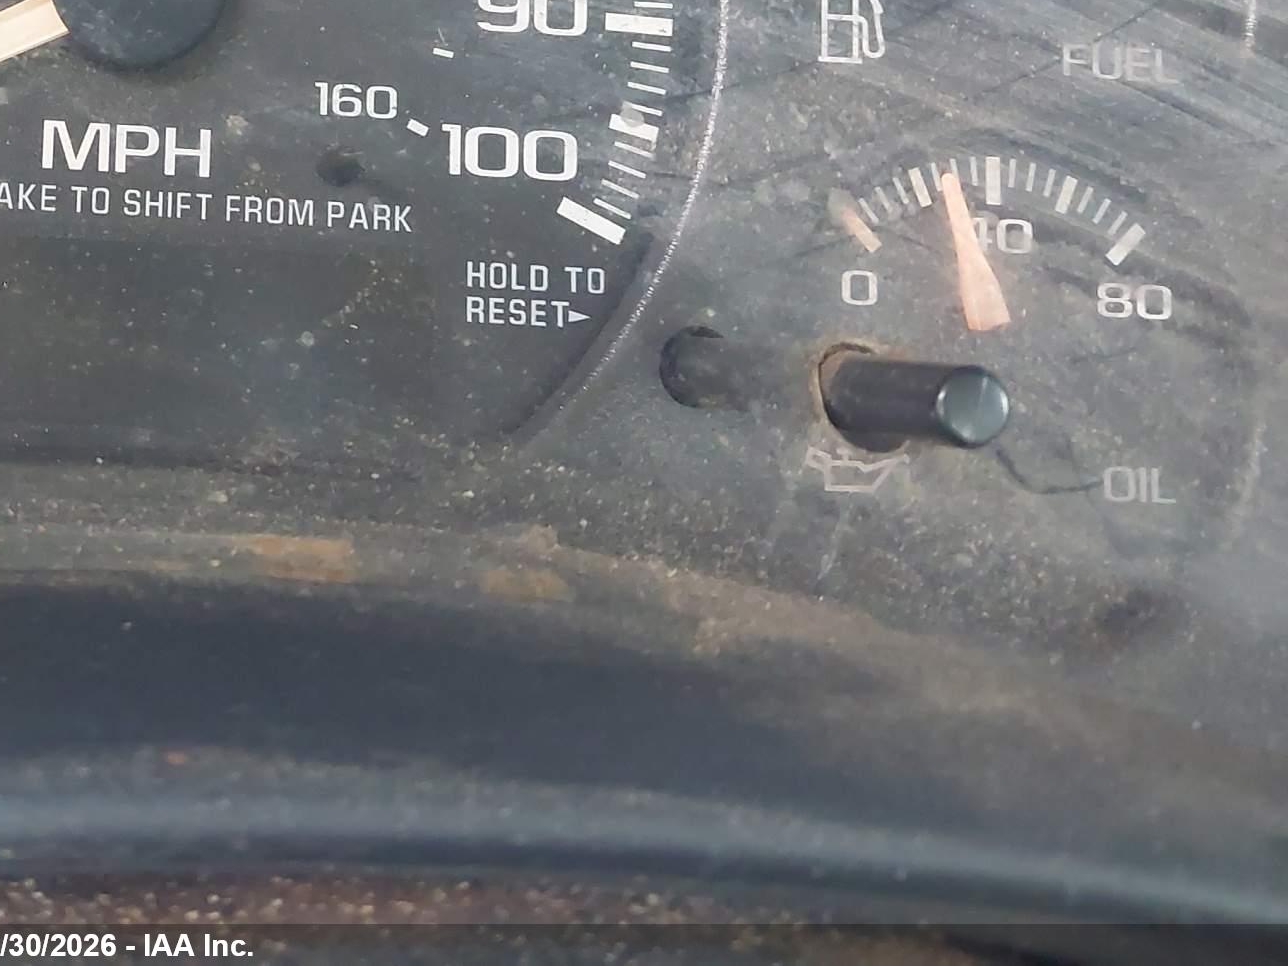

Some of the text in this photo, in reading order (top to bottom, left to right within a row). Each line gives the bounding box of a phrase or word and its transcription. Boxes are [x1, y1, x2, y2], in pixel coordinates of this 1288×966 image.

[1062, 41, 1180, 85] FUEL
[314, 81, 399, 120] 160
[41, 119, 212, 179] MPH
[441, 122, 578, 181] 100
[71, 185, 110, 215] TO
[123, 189, 214, 221] SHIFT
[225, 194, 314, 227] FROM
[327, 200, 412, 233] PARK
[466, 261, 606, 295] HOLD TO
[841, 269, 878, 307] 0
[466, 296, 568, 328] RESET
[1097, 282, 1173, 321] 80
[1103, 466, 1177, 505] OIL
